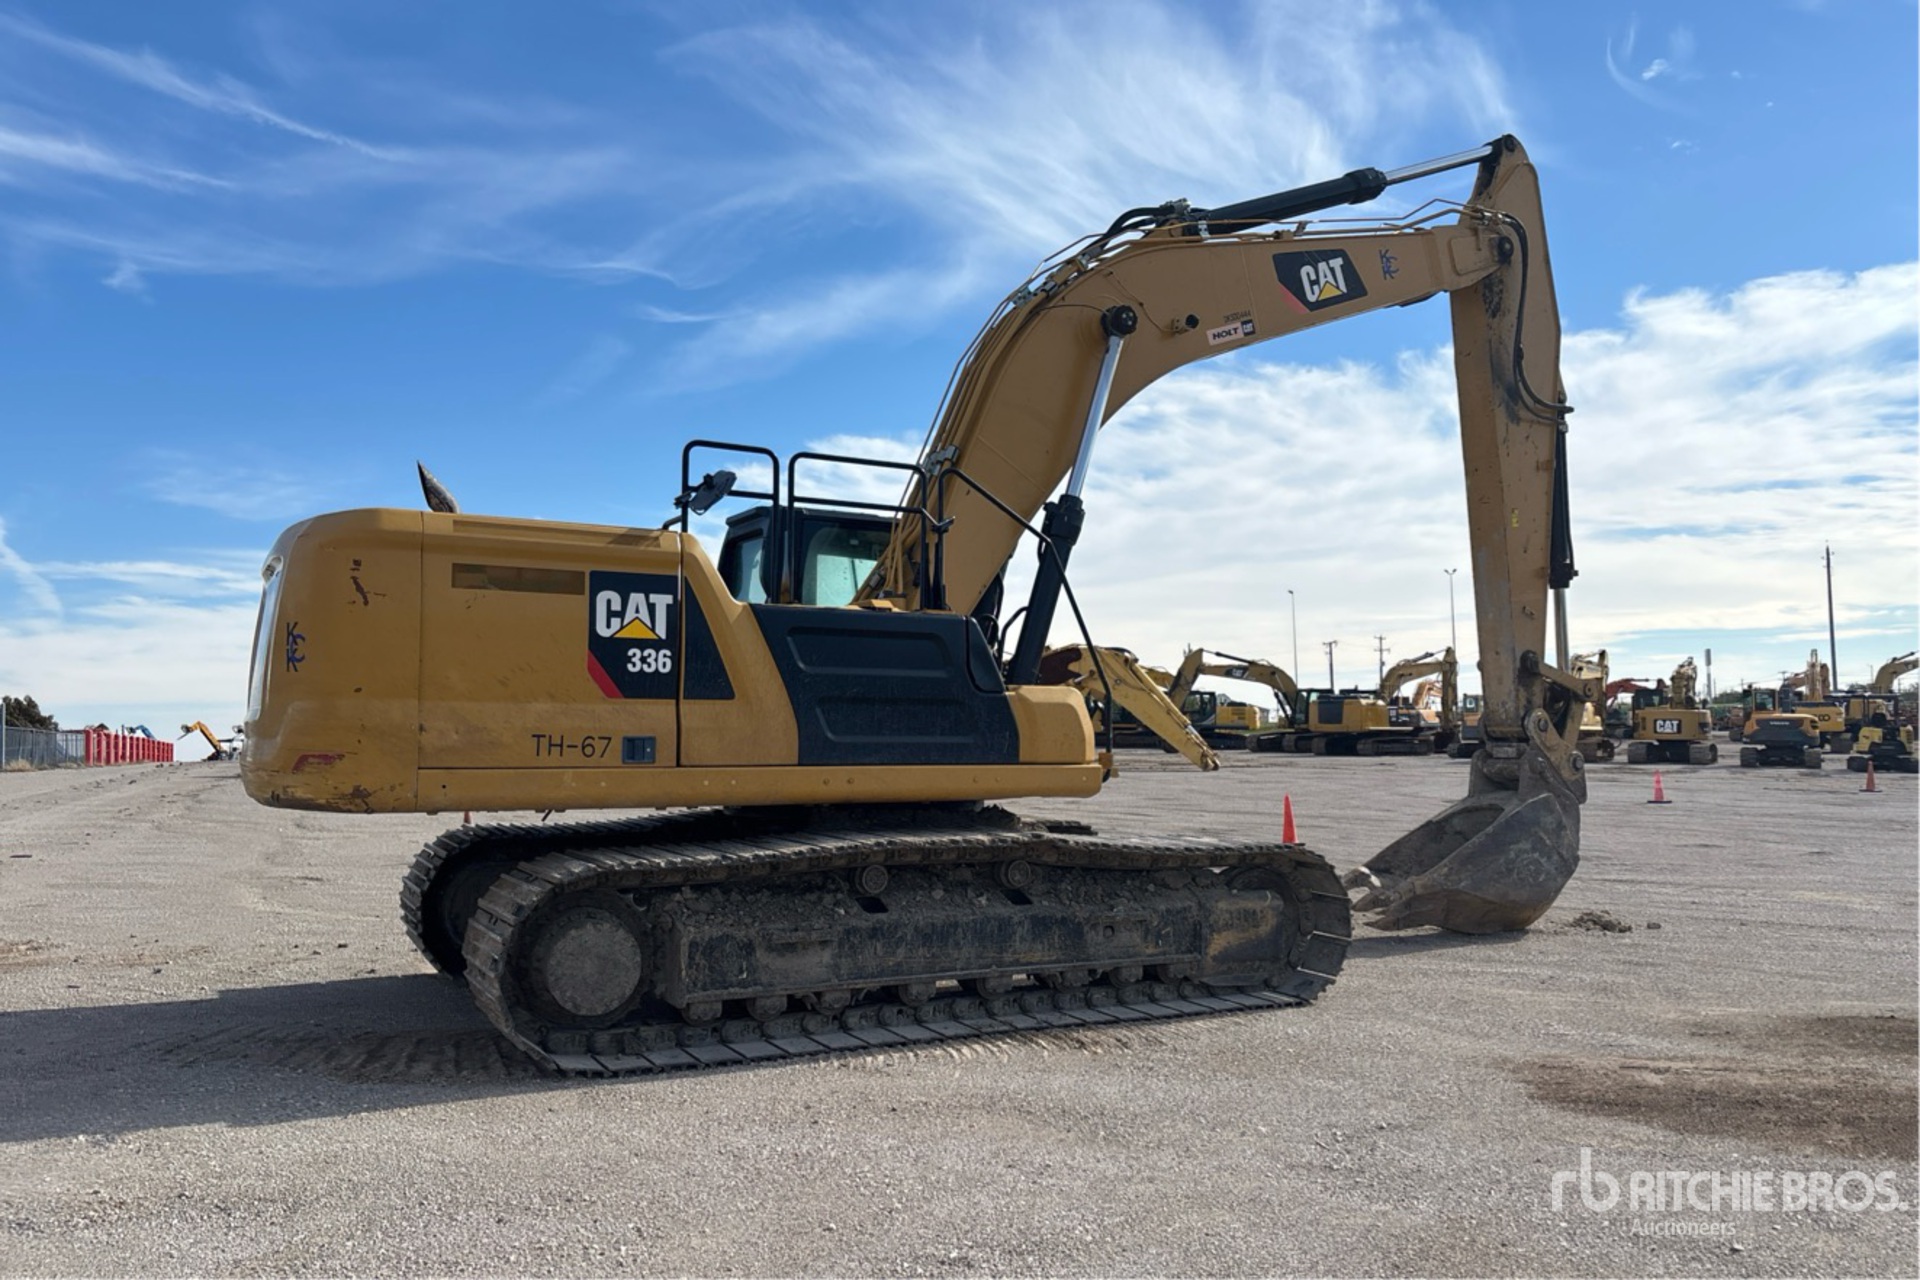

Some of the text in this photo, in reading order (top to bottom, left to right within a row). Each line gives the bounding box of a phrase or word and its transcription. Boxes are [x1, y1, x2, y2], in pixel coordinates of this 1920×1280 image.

[1300, 257, 1347, 302] CAT
[1212, 327, 1238, 340] HOLT
[596, 590, 673, 639] CAT
[627, 648, 672, 673] 336
[1656, 719, 1679, 733] CAT
[531, 734, 612, 758] TH-67
